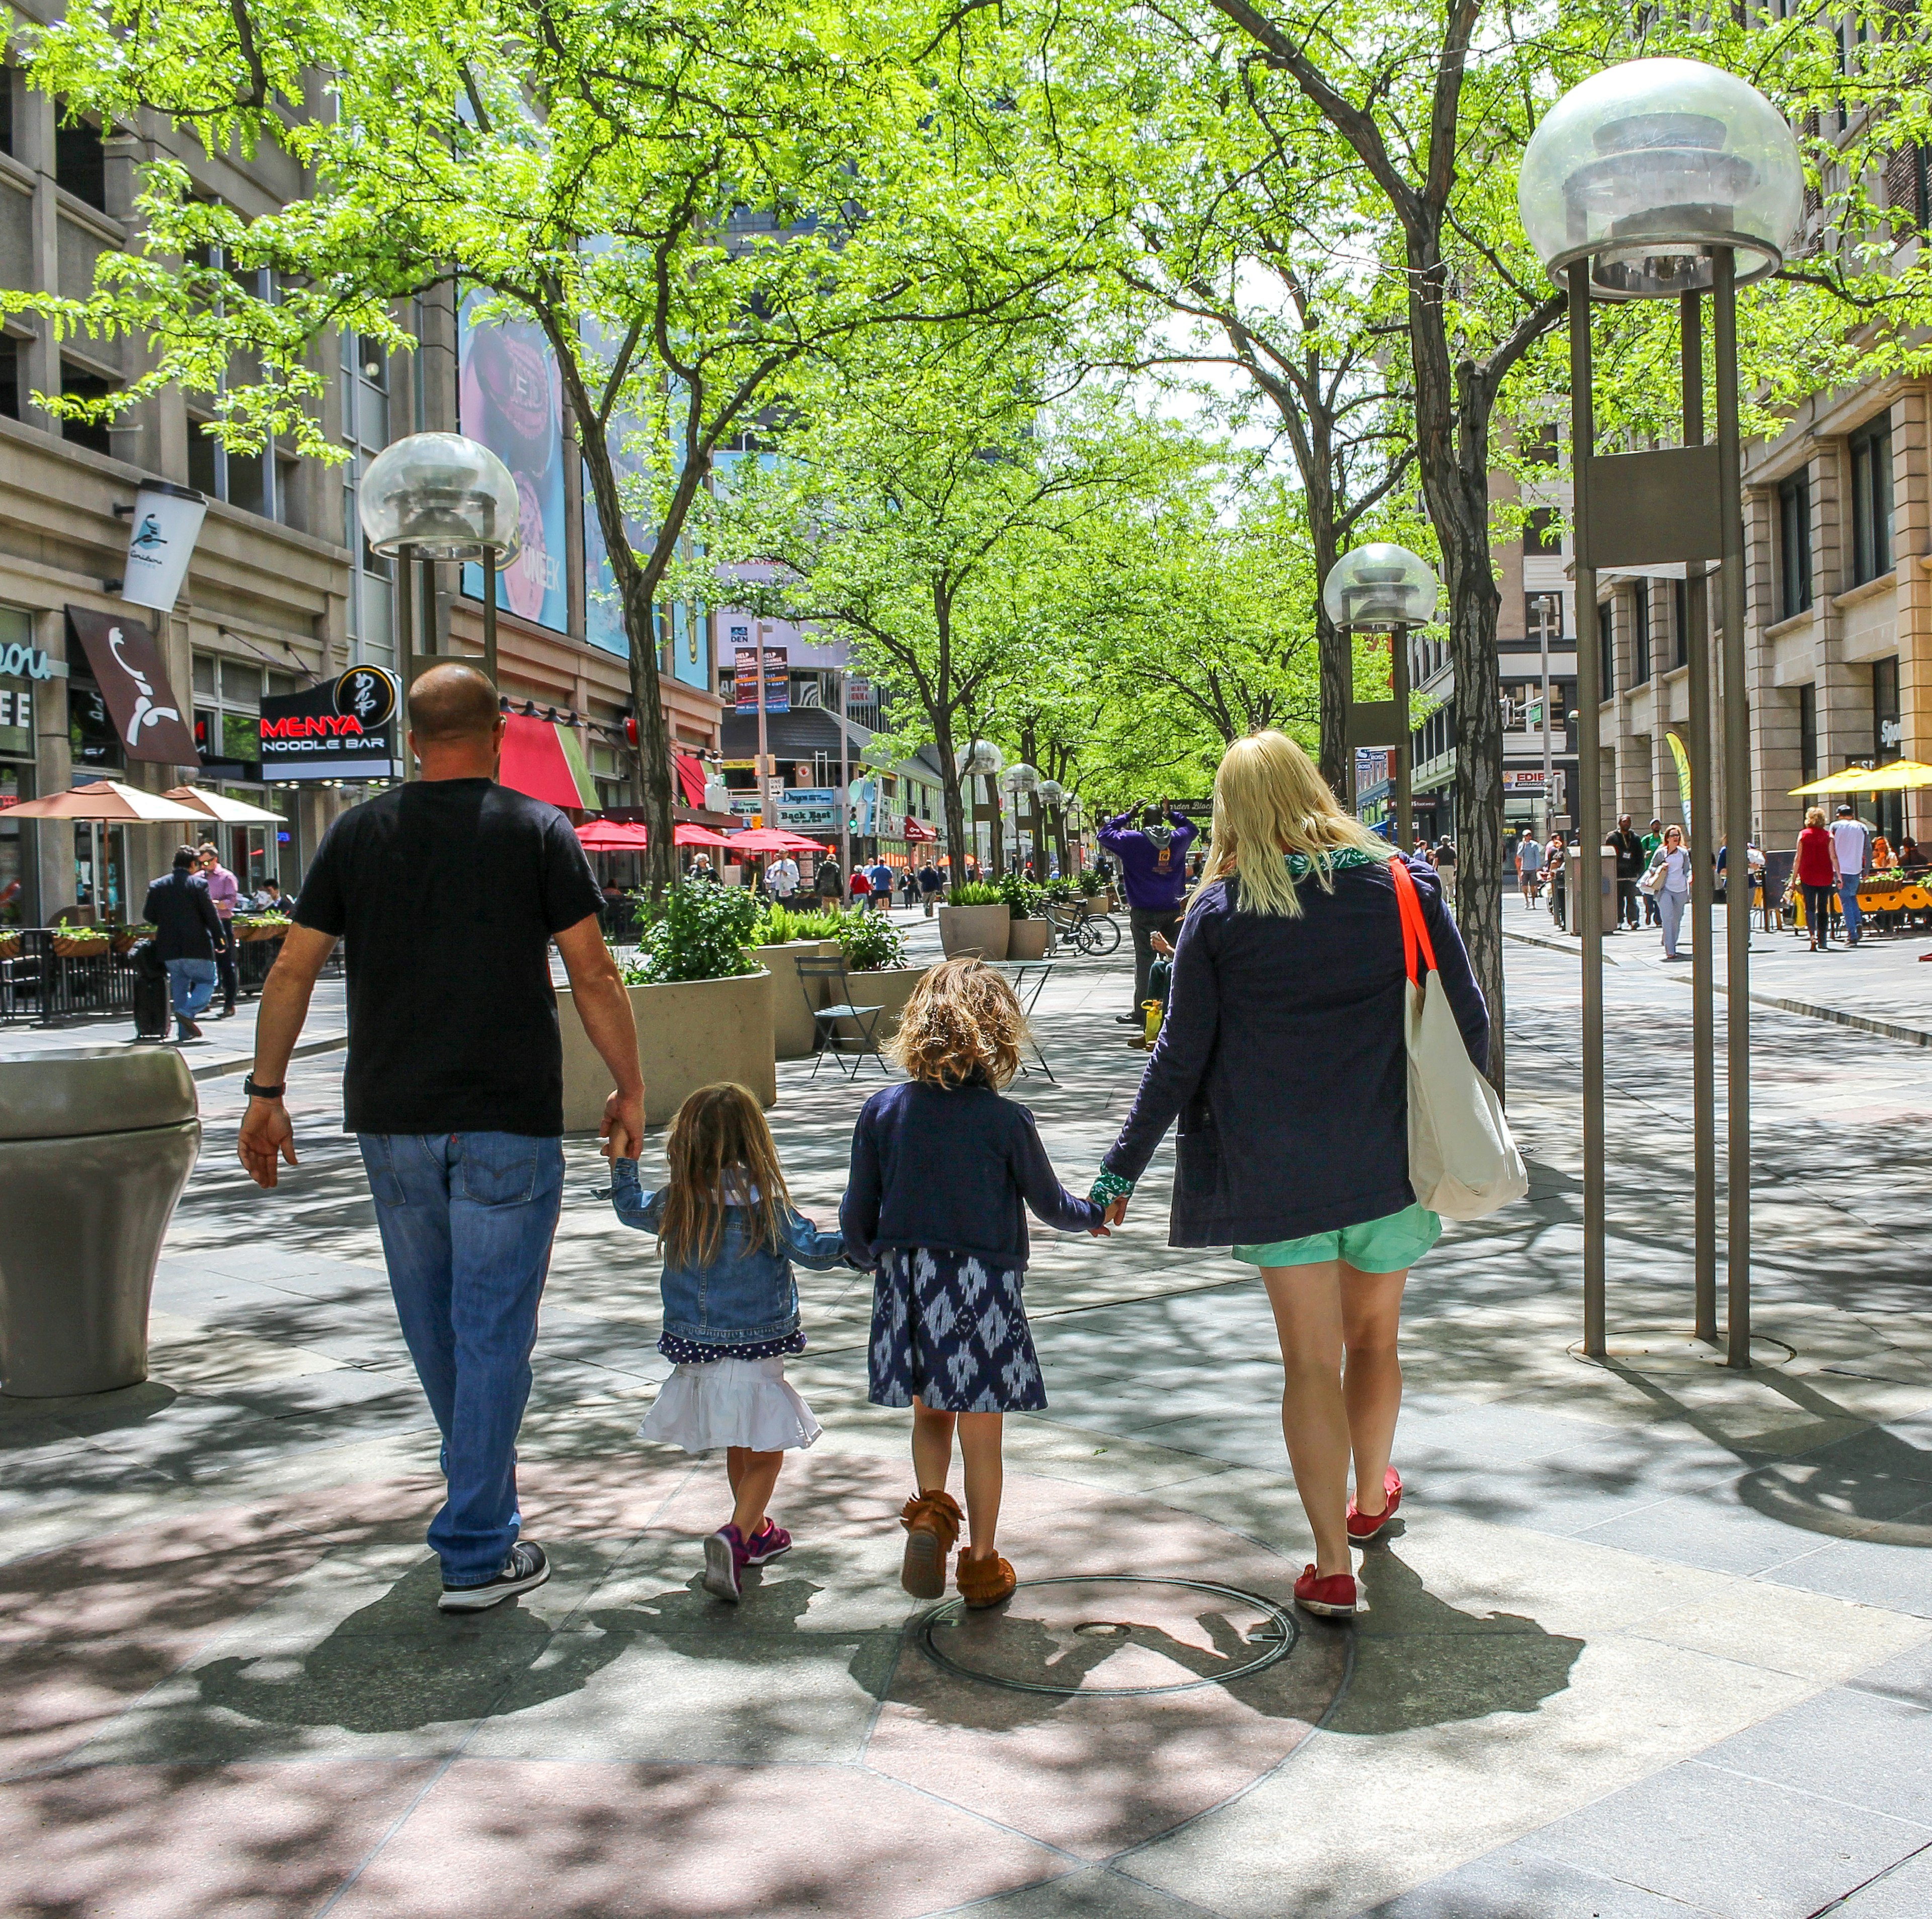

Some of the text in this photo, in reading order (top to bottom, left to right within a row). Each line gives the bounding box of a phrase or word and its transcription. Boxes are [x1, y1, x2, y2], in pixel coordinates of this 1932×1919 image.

[260, 714, 363, 738] MENYA
[262, 738, 385, 752] NOODLE BAR
[781, 811, 831, 820] Back East
